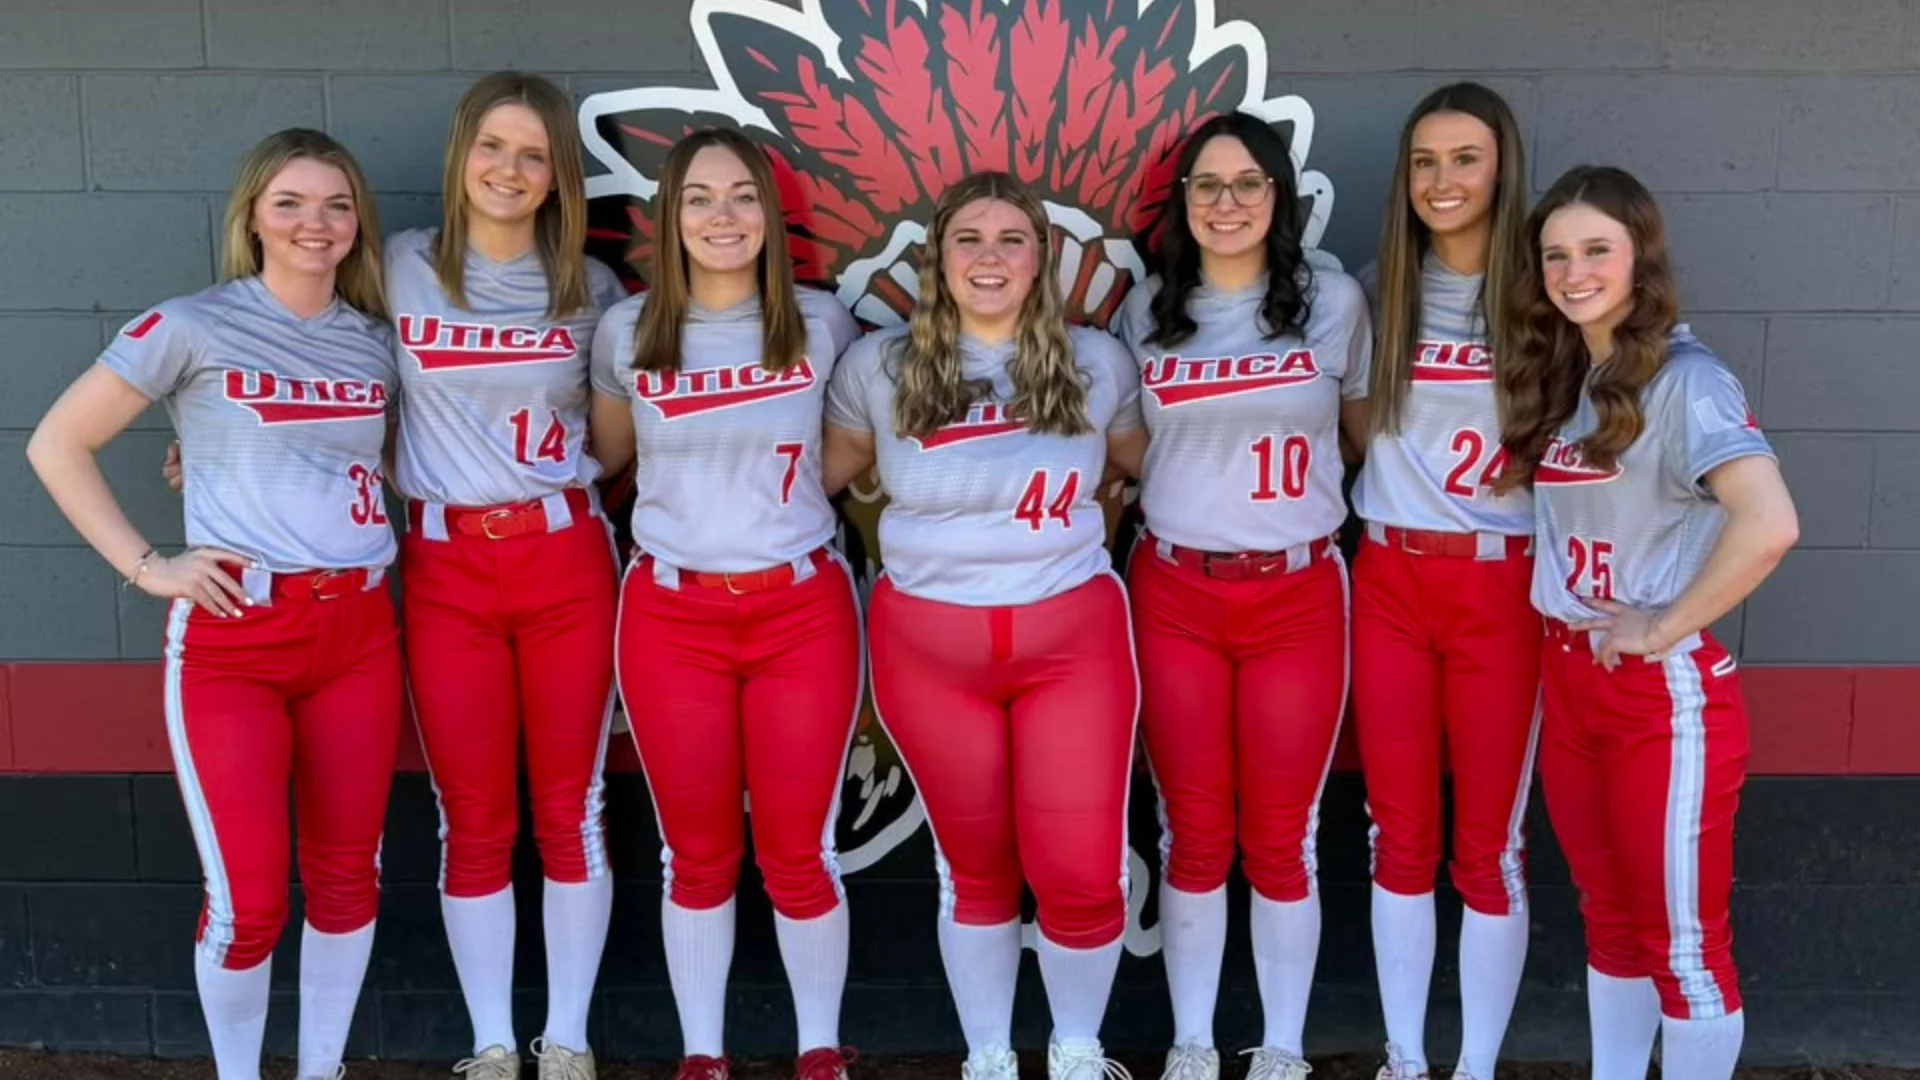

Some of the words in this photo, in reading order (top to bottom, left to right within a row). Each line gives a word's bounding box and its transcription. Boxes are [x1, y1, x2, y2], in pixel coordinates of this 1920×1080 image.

[399, 314, 576, 351] UTICA
[1414, 340, 1495, 368] TIC
[224, 369, 386, 404] UTICA
[635, 355, 815, 401] UTICA
[1143, 349, 1319, 385] UTICA
[508, 407, 568, 466] 14
[1443, 426, 1512, 499] 24
[346, 461, 388, 527] 32
[775, 442, 804, 507] 7
[1250, 433, 1311, 503] 10
[1013, 468, 1081, 532] 44
[1565, 533, 1616, 601] 25
